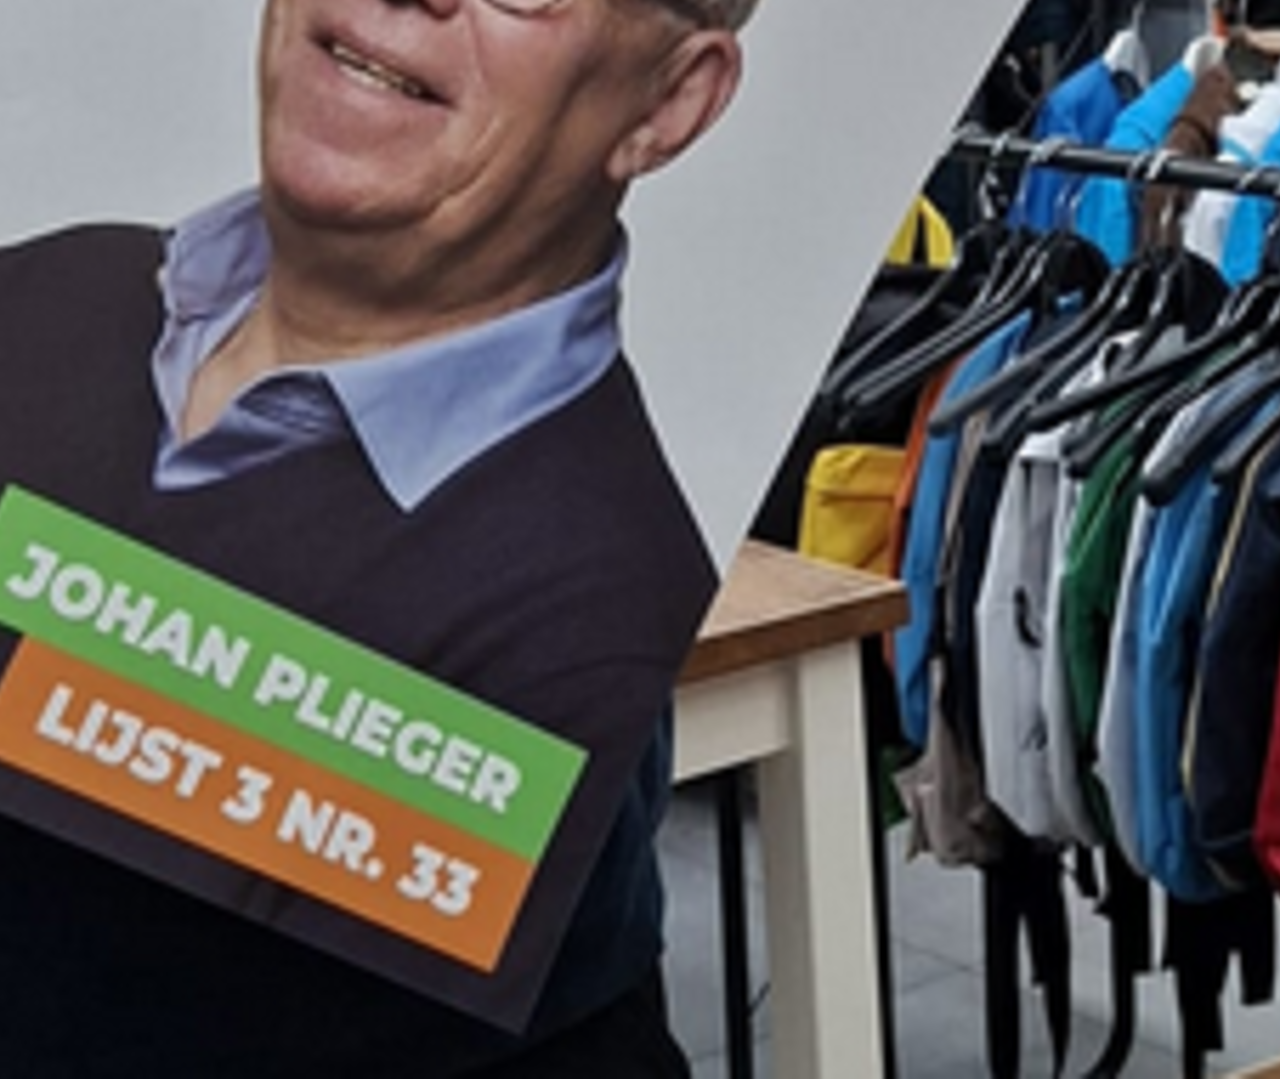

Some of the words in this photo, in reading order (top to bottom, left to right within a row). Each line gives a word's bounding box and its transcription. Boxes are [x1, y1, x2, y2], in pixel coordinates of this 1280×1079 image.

[5, 542, 252, 689] JOHAN
[252, 652, 523, 814] PLIEGER
[34, 683, 223, 800] LIJST
[220, 765, 274, 825] 3
[275, 789, 384, 881] NR.
[394, 843, 481, 918] 33
